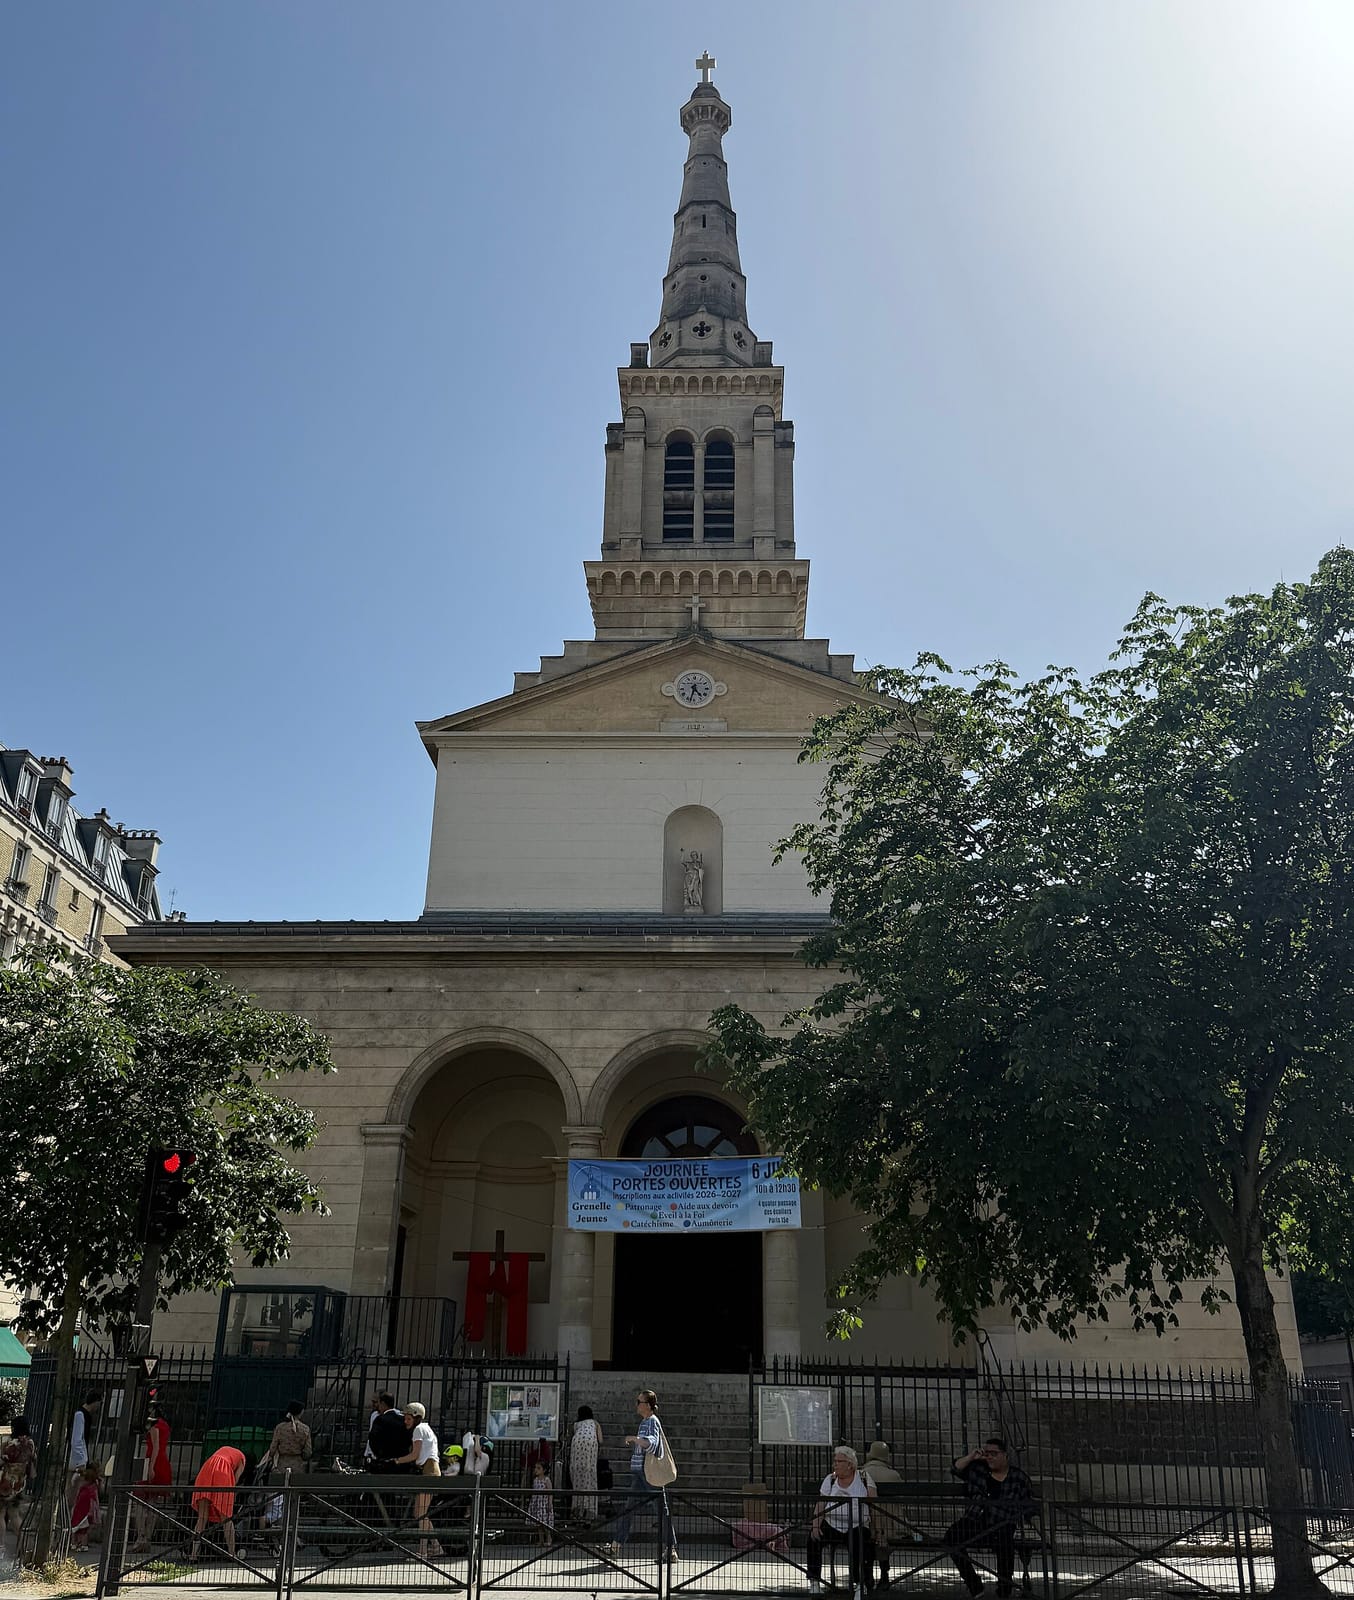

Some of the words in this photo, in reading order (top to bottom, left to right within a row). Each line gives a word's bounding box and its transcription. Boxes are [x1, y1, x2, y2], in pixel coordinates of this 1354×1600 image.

[644, 1162, 709, 1177] JOURNÉE
[752, 1162, 760, 1179] 6
[612, 1177, 666, 1191] PORTES
[669, 1176, 742, 1190] OUVERTES
[755, 1184, 767, 1194] 10h
[769, 1183, 774, 1193] à
[775, 1183, 796, 1193] 12h30
[612, 1191, 651, 1201] Inscriptions
[667, 1191, 694, 1199] activités
[572, 1202, 611, 1210] Grenelle
[625, 1203, 662, 1212] Patronage
[677, 1202, 695, 1210] Aide
[576, 1214, 608, 1223] Jeunes
[693, 1211, 705, 1219] Foi
[630, 1220, 674, 1228] Catéchisme
[691, 1219, 733, 1227] Aumônerie
